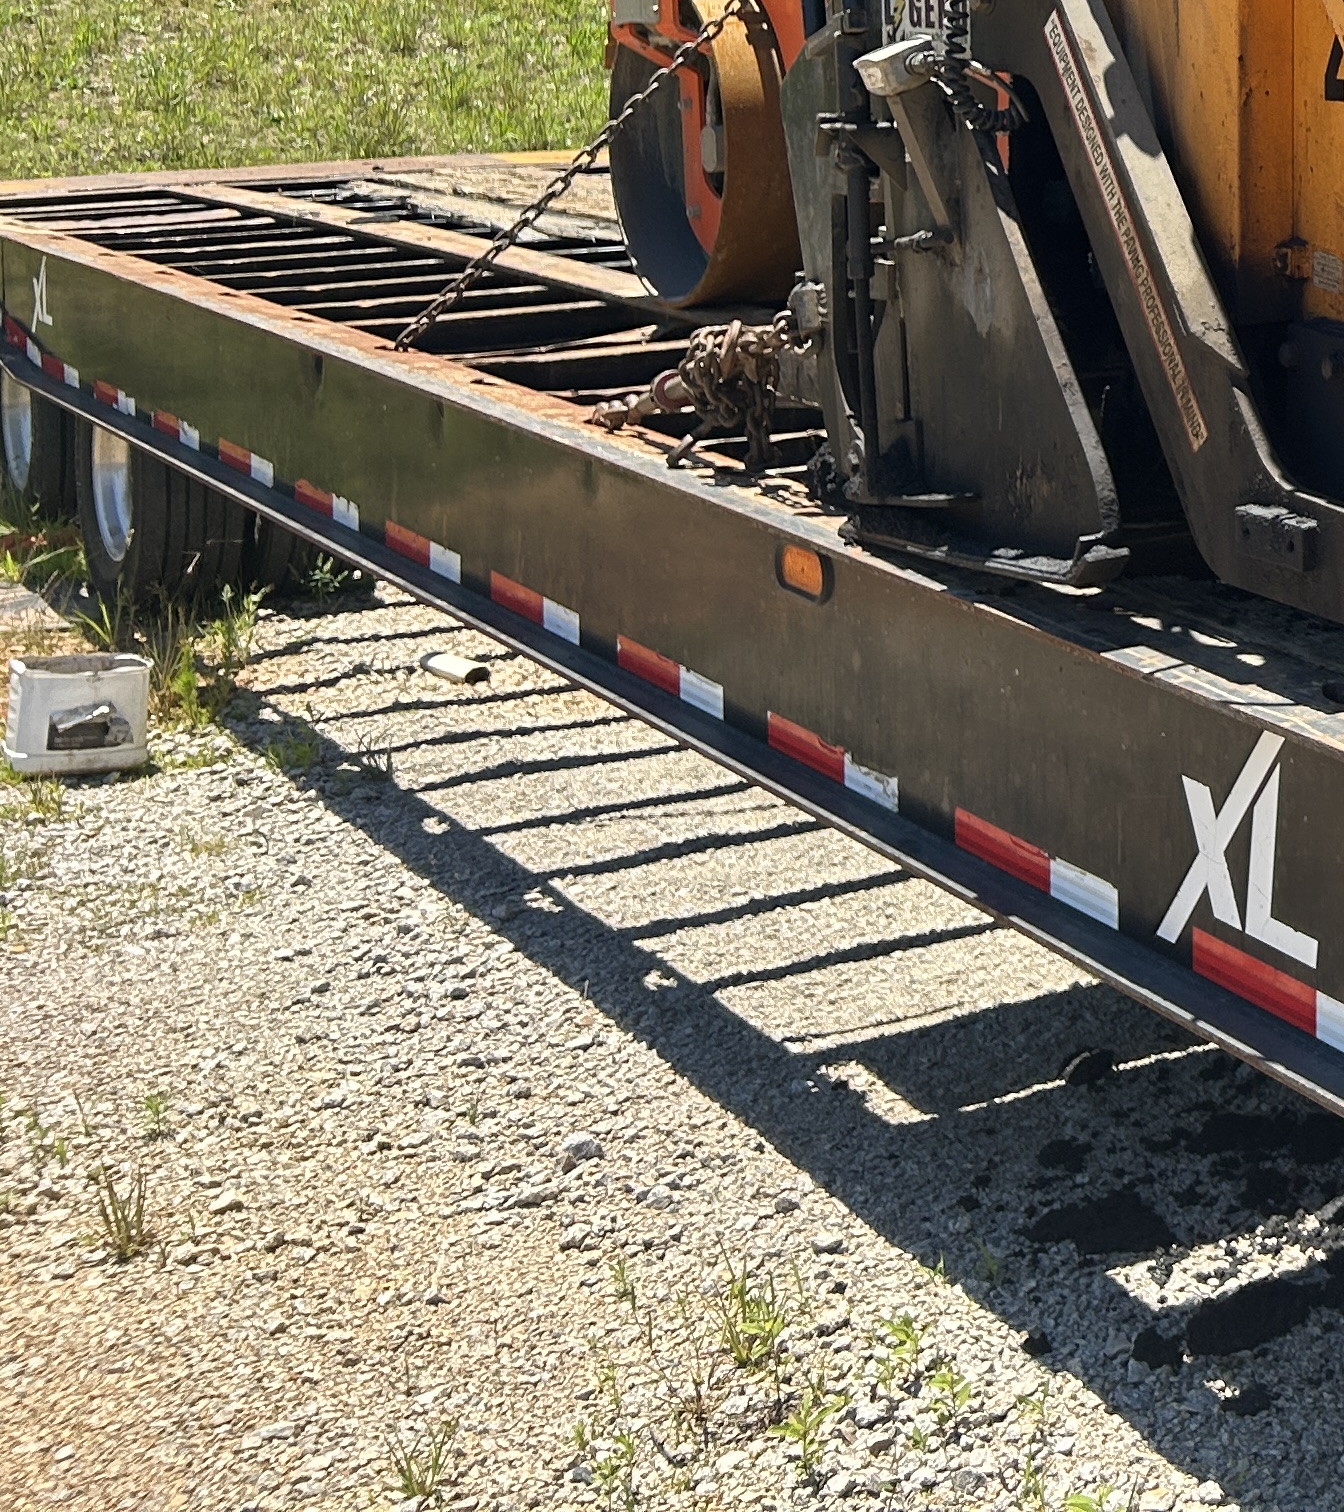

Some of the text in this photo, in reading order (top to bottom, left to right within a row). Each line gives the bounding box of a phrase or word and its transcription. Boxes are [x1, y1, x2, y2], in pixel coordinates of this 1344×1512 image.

[32, 255, 53, 332] XL
[1075, 97, 1104, 166] DESIGNED
[1099, 163, 1117, 202] WITH
[1112, 198, 1128, 230] THE
[1121, 227, 1145, 278] PAVING
[1139, 276, 1182, 386] PROFESSIONAL
[1157, 730, 1319, 969] XL
